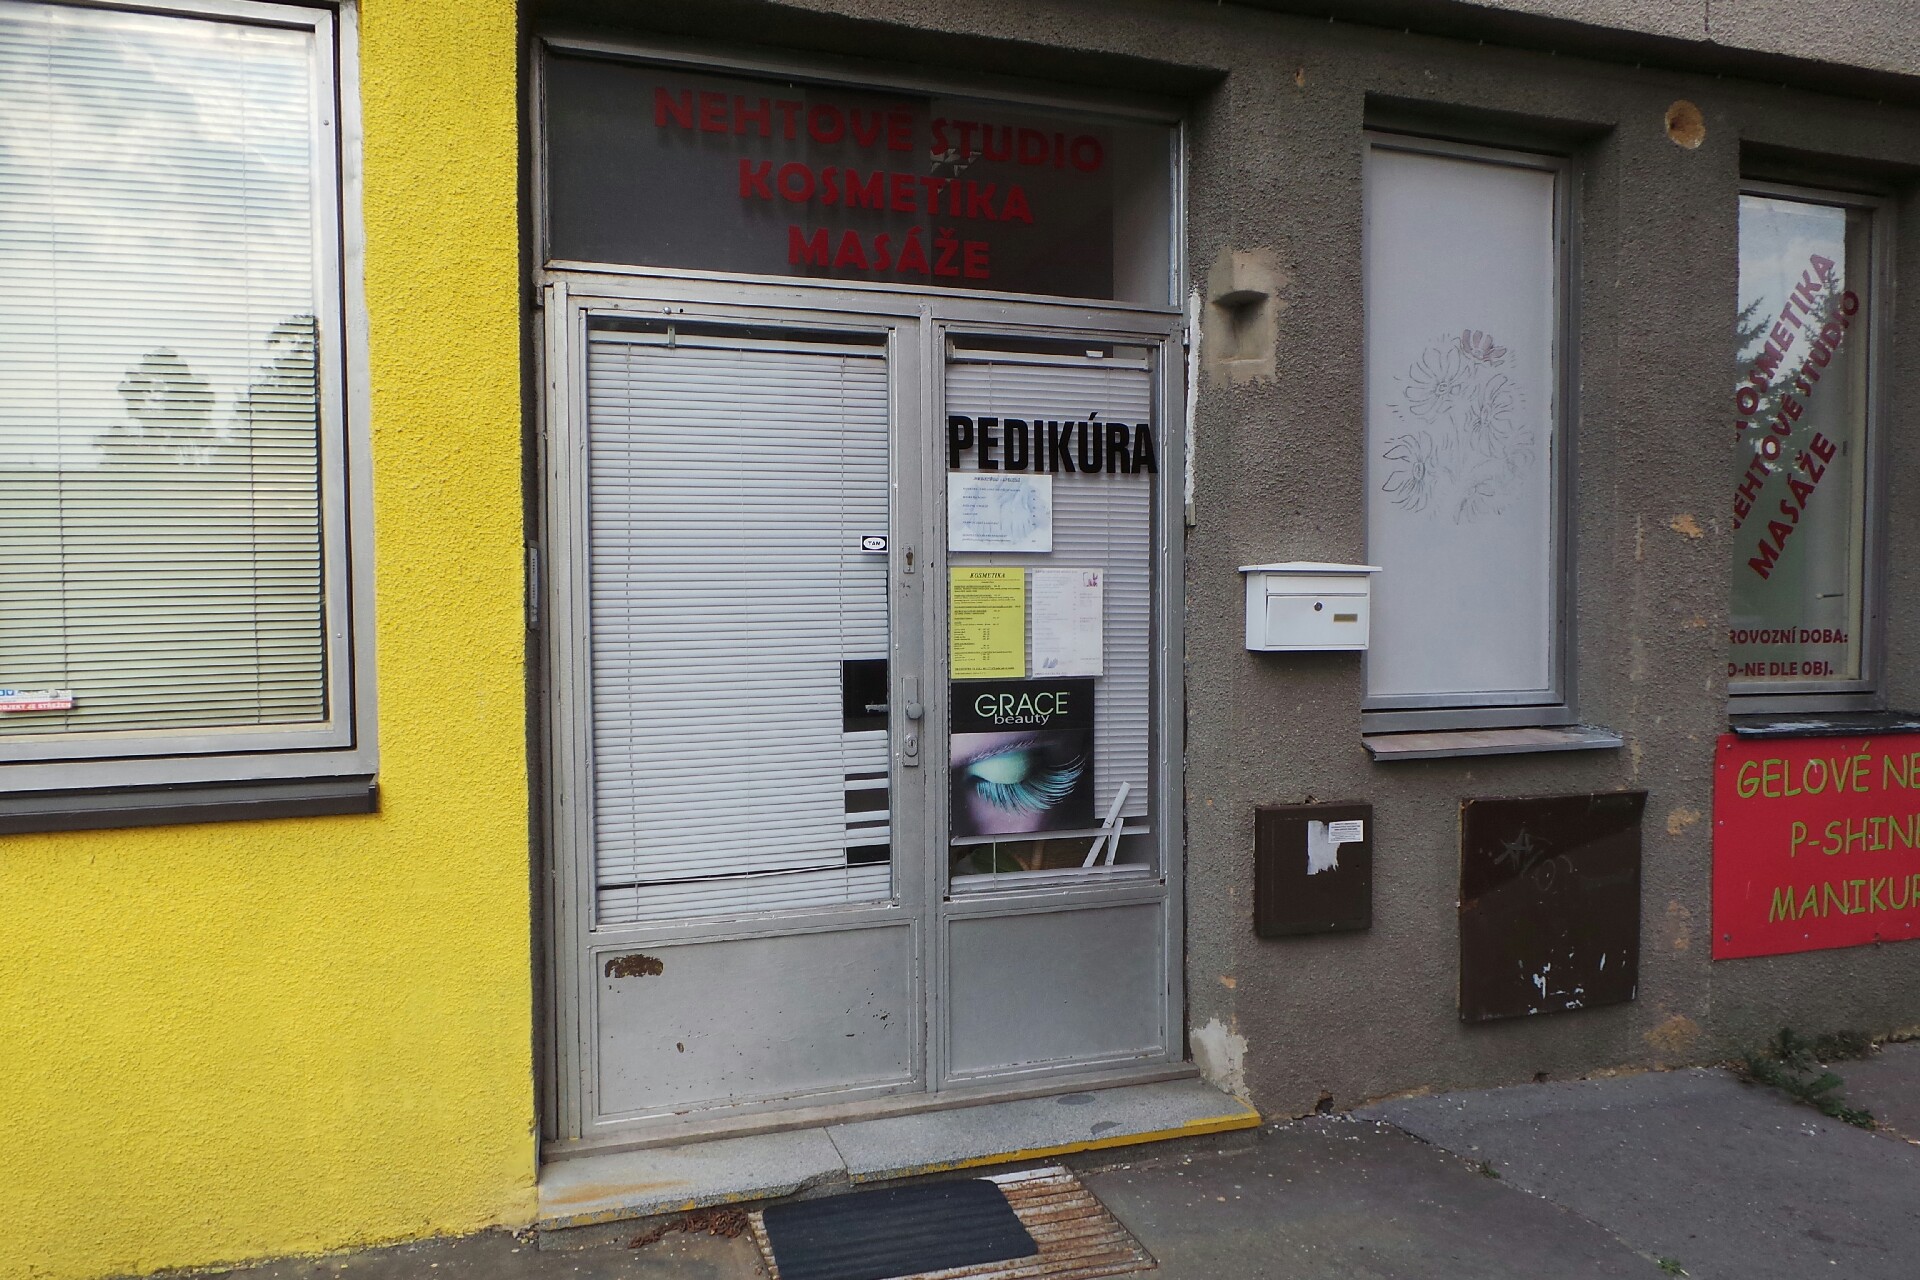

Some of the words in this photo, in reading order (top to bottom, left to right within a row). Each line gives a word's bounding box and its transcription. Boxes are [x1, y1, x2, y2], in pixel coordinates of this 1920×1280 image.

[654, 87, 913, 151] NEHTOVÉ
[930, 117, 1104, 172] STUDIO
[739, 158, 1033, 225] KOSMETIKA
[788, 225, 990, 280] MASÁŽE
[1733, 392, 1804, 530] EHTOVÉ
[1795, 290, 1859, 397] STUDIO
[948, 411, 1158, 474] PEDIKÚRA
[1747, 432, 1837, 580] MASÁŽE
[1800, 629, 1848, 644] DOBA:
[1769, 661, 1798, 676] DLE
[1801, 661, 1834, 677] OBJ.
[974, 691, 1069, 718] GRACE
[994, 713, 1050, 726] beauty
[1736, 741, 1872, 799] GELOVÉ
